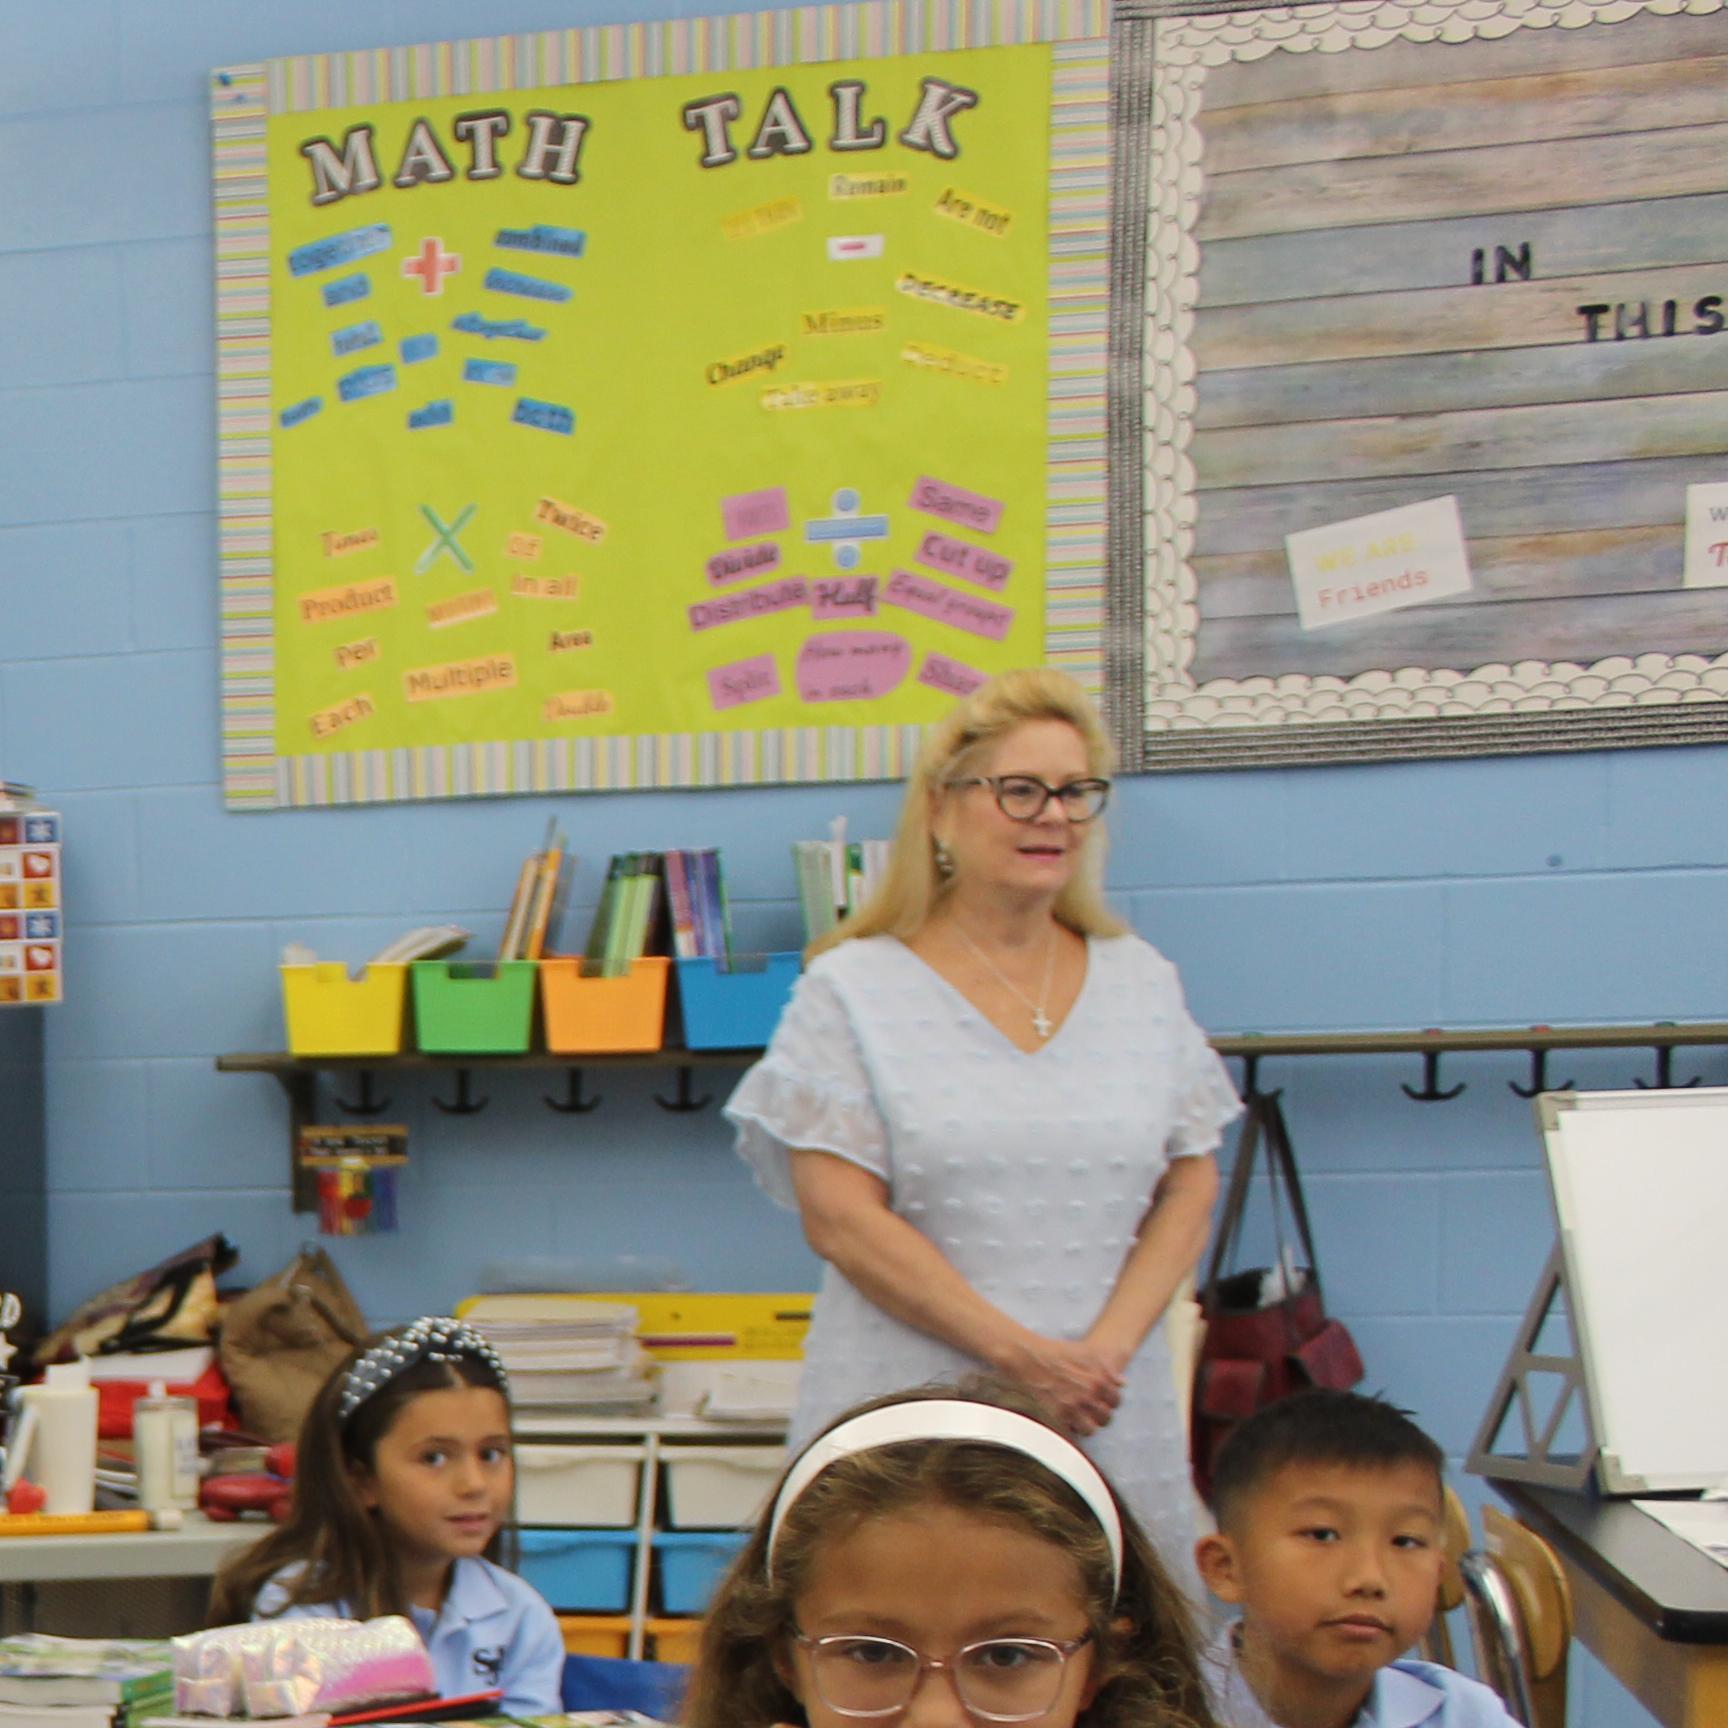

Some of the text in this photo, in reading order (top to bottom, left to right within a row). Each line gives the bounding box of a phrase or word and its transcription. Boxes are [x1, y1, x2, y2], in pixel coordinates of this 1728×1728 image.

[300, 76, 979, 207] MATH TALK
[832, 174, 907, 197] Remain
[934, 186, 1011, 236] Are not
[1470, 241, 1532, 286] IN
[899, 272, 1021, 321] DECREASE
[803, 311, 883, 334] Minus
[1576, 294, 1725, 342] THIS
[707, 344, 786, 385] Change
[536, 498, 604, 541] Twice
[922, 484, 992, 522] Same
[922, 532, 1010, 583] Cut up
[301, 582, 394, 620] Product
[817, 577, 878, 613] Half
[1316, 568, 1430, 608] Friends
[407, 657, 514, 695] Multiple
[925, 658, 984, 691] Shar
